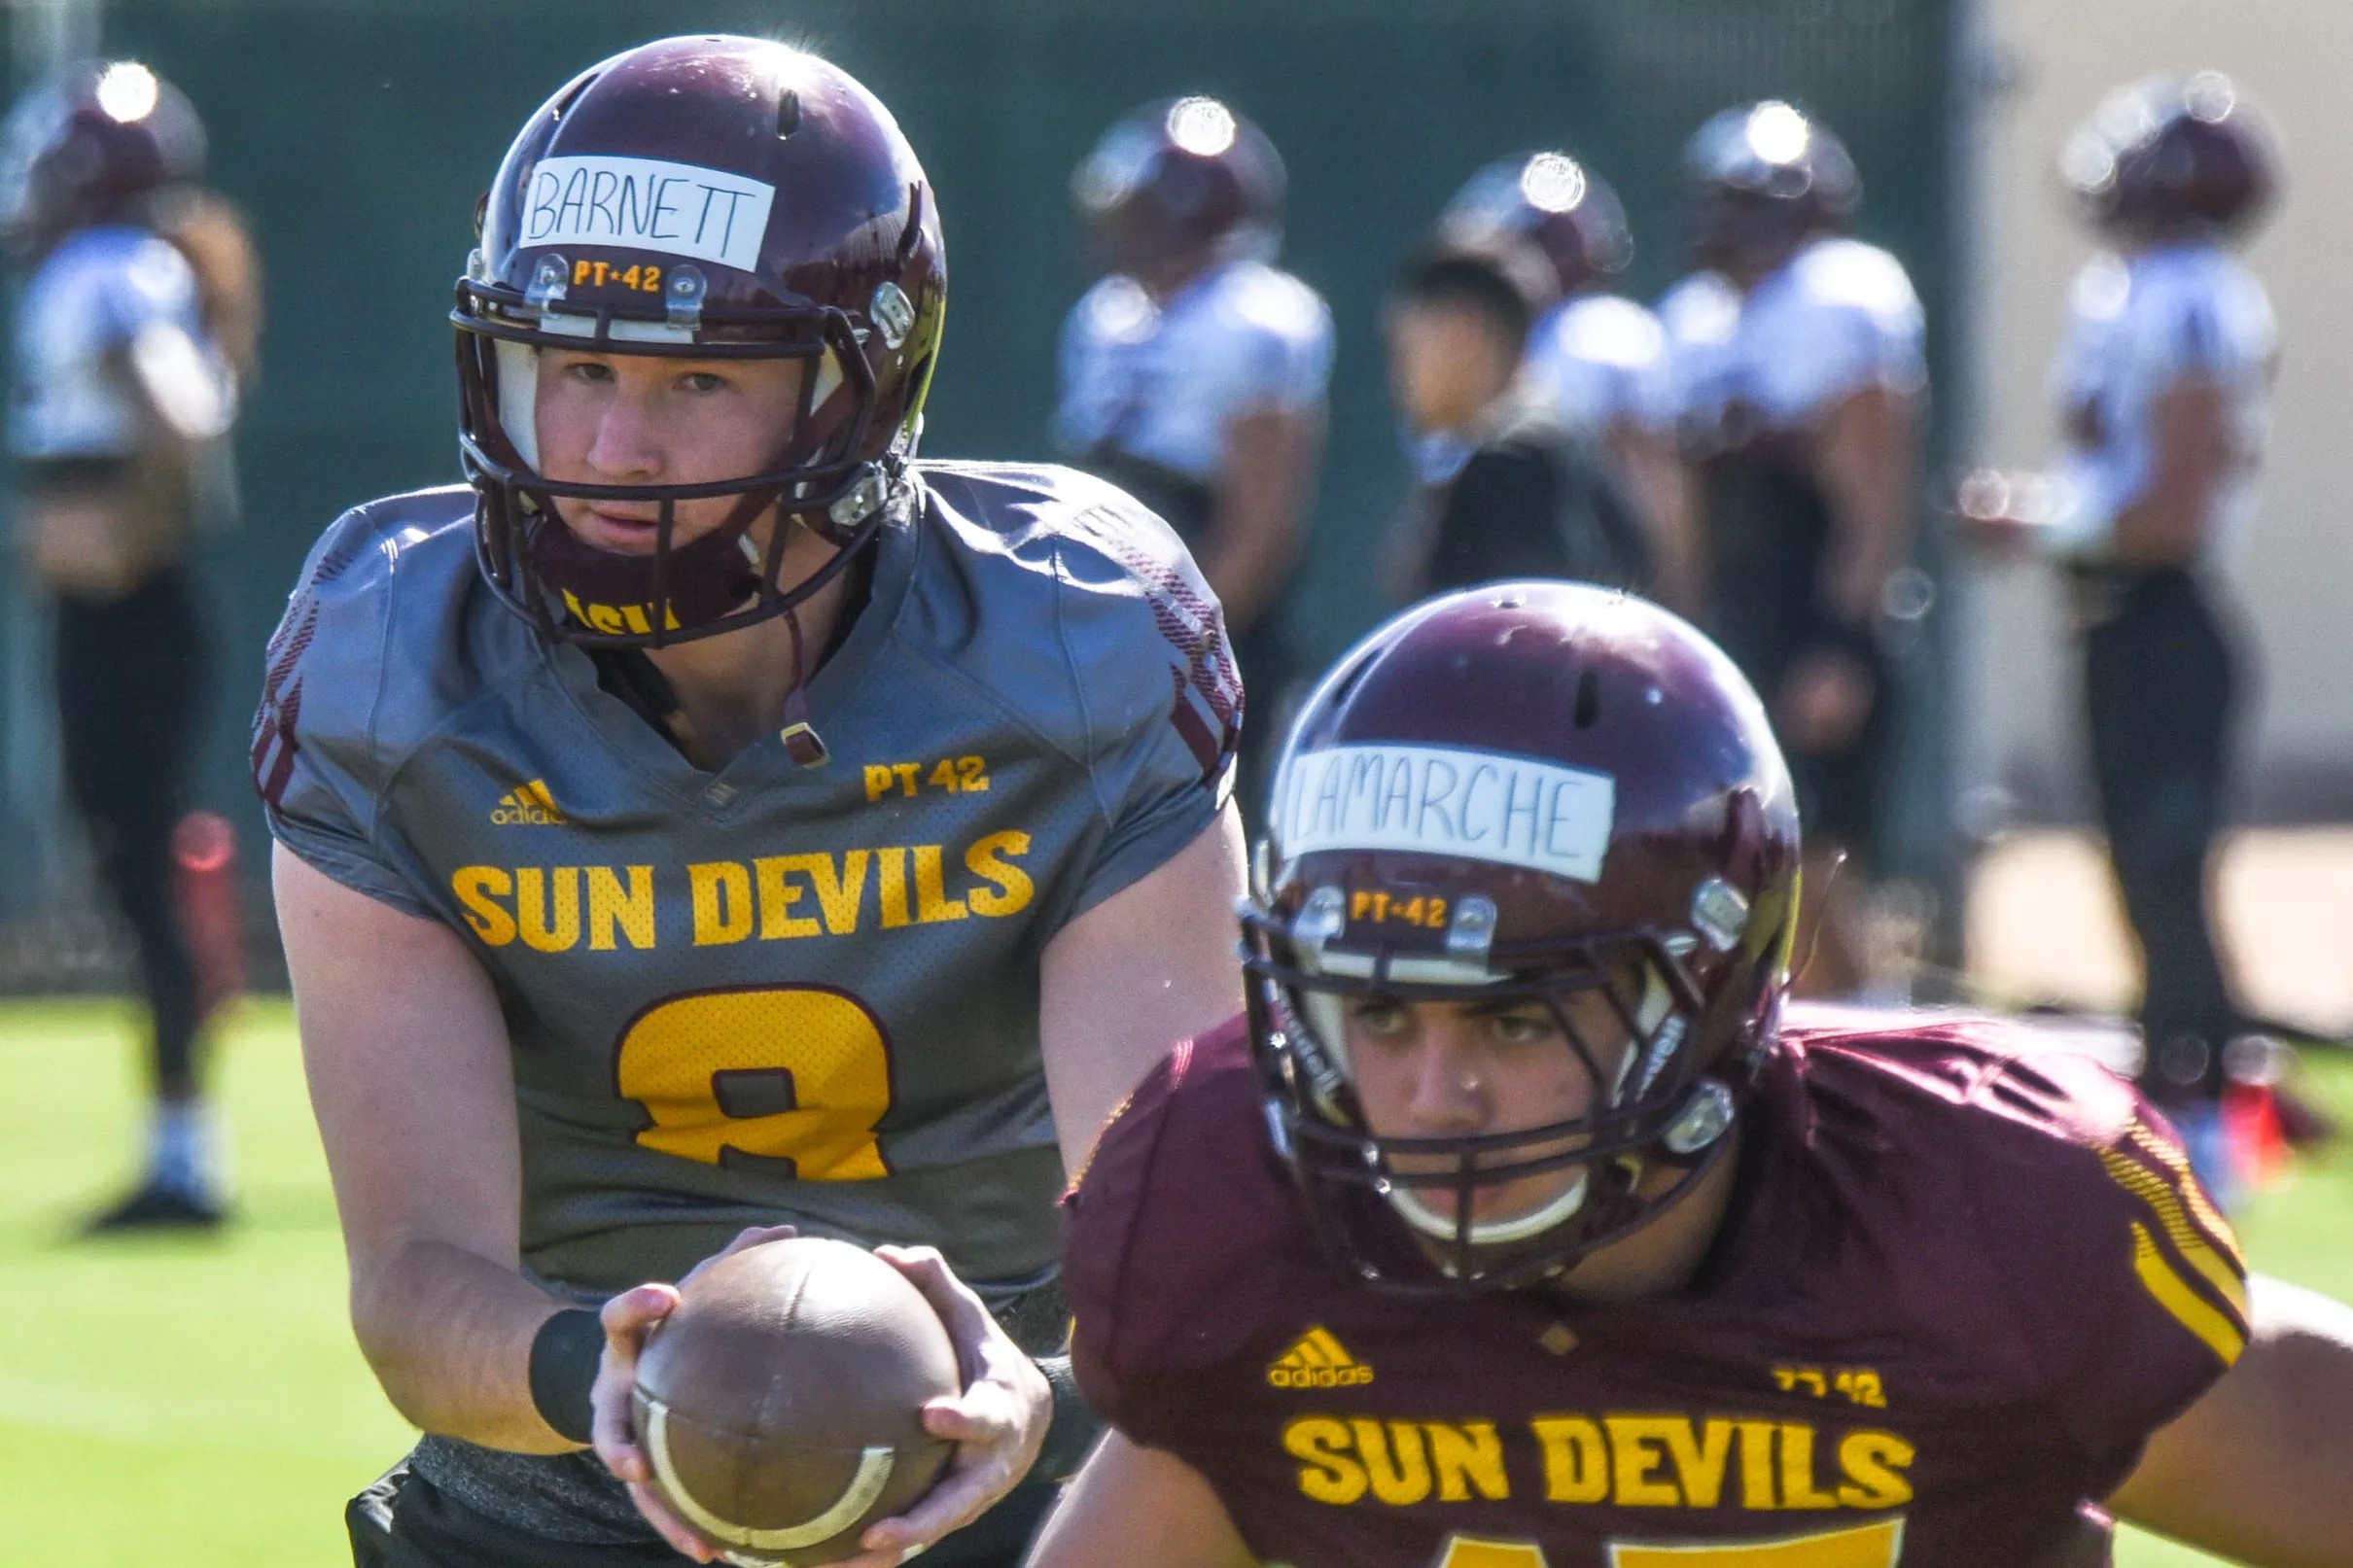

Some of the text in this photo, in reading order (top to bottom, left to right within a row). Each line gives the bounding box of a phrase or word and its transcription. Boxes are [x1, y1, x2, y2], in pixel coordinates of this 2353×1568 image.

[528, 167, 755, 259] BARNETT
[863, 754, 991, 802] PT 42
[1291, 753, 1583, 857] LAMARCHE
[451, 829, 1036, 954] SUN DEVILS
[612, 980, 897, 1181] 8
[1269, 1364, 1375, 1388] adidas
[1282, 1412, 1916, 1512] SUN DEVILS
